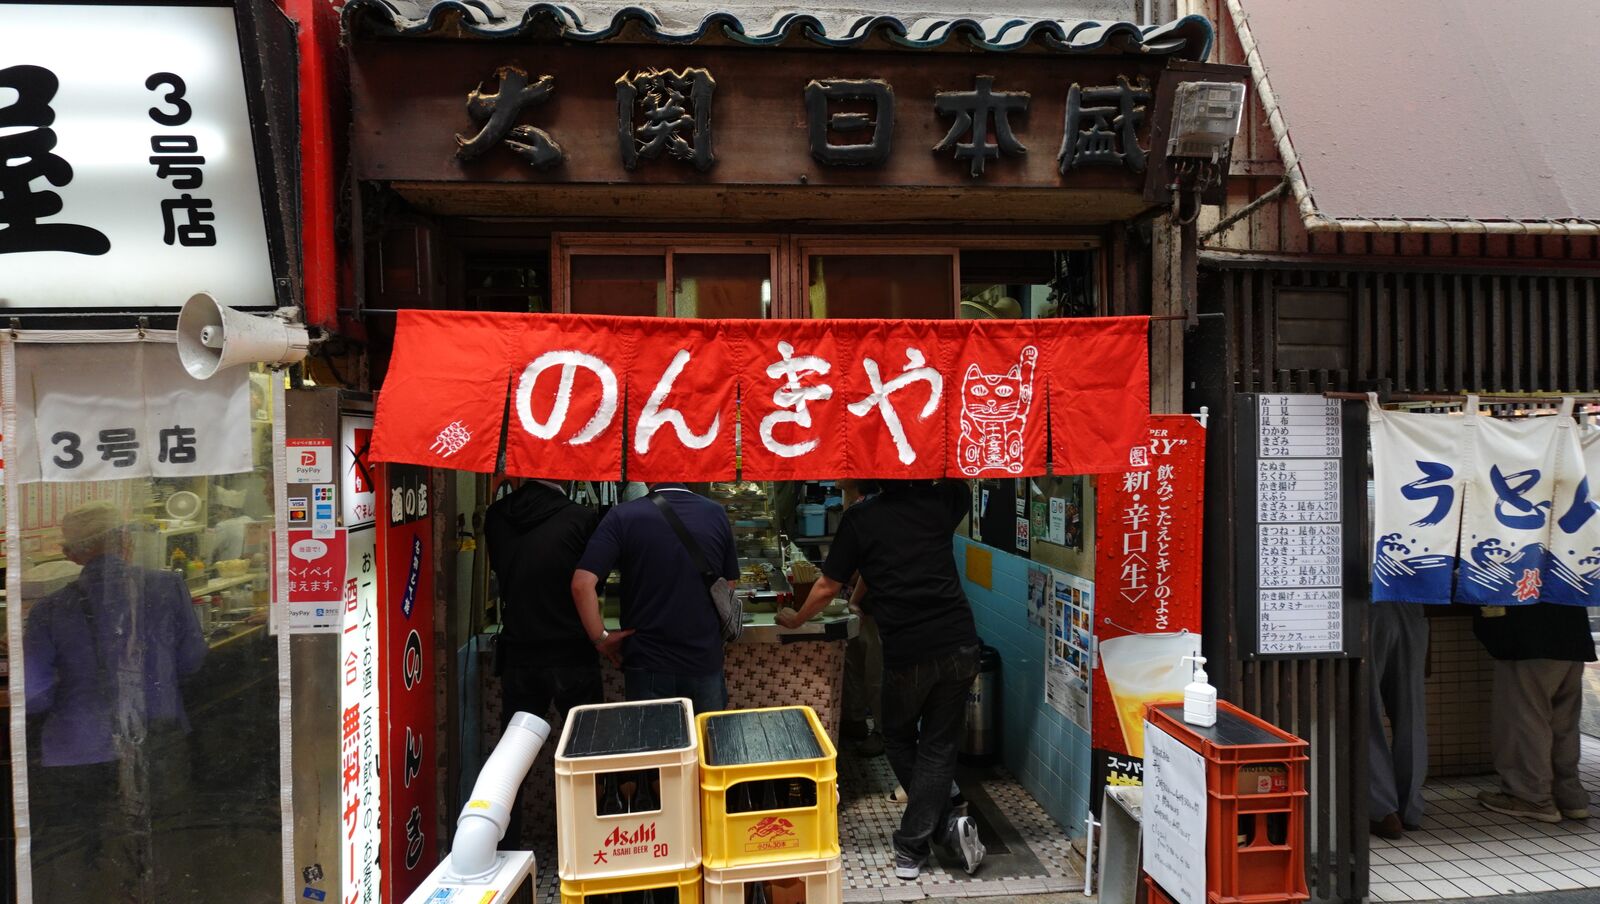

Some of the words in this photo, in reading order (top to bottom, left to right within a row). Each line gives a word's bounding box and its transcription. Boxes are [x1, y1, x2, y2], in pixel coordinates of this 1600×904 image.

[145, 72, 216, 247] 3号店
[515, 340, 943, 466] のんきや
[1262, 427, 1288, 435] わかめ
[1262, 437, 1288, 446] きざみ
[51, 425, 196, 469] 3号店
[1262, 447, 1289, 456] きつね
[1326, 447, 1339, 455] 230
[1260, 462, 1286, 470] たぬき
[1324, 462, 1337, 470] 230
[1260, 472, 1296, 480] ちくわ天
[1154, 464, 1174, 630] 飲みごたえとキレのよさ
[1262, 557, 1297, 565] スタミナ
[289, 567, 333, 578] ペイペイ
[1262, 623, 1286, 631] カレー
[1262, 633, 1303, 641] デラックス
[604, 822, 656, 847] Asahi
[593, 850, 607, 864] 大
[613, 847, 631, 856] ASAHI
[633, 845, 648, 854] BEER
[654, 843, 668, 858] 20
